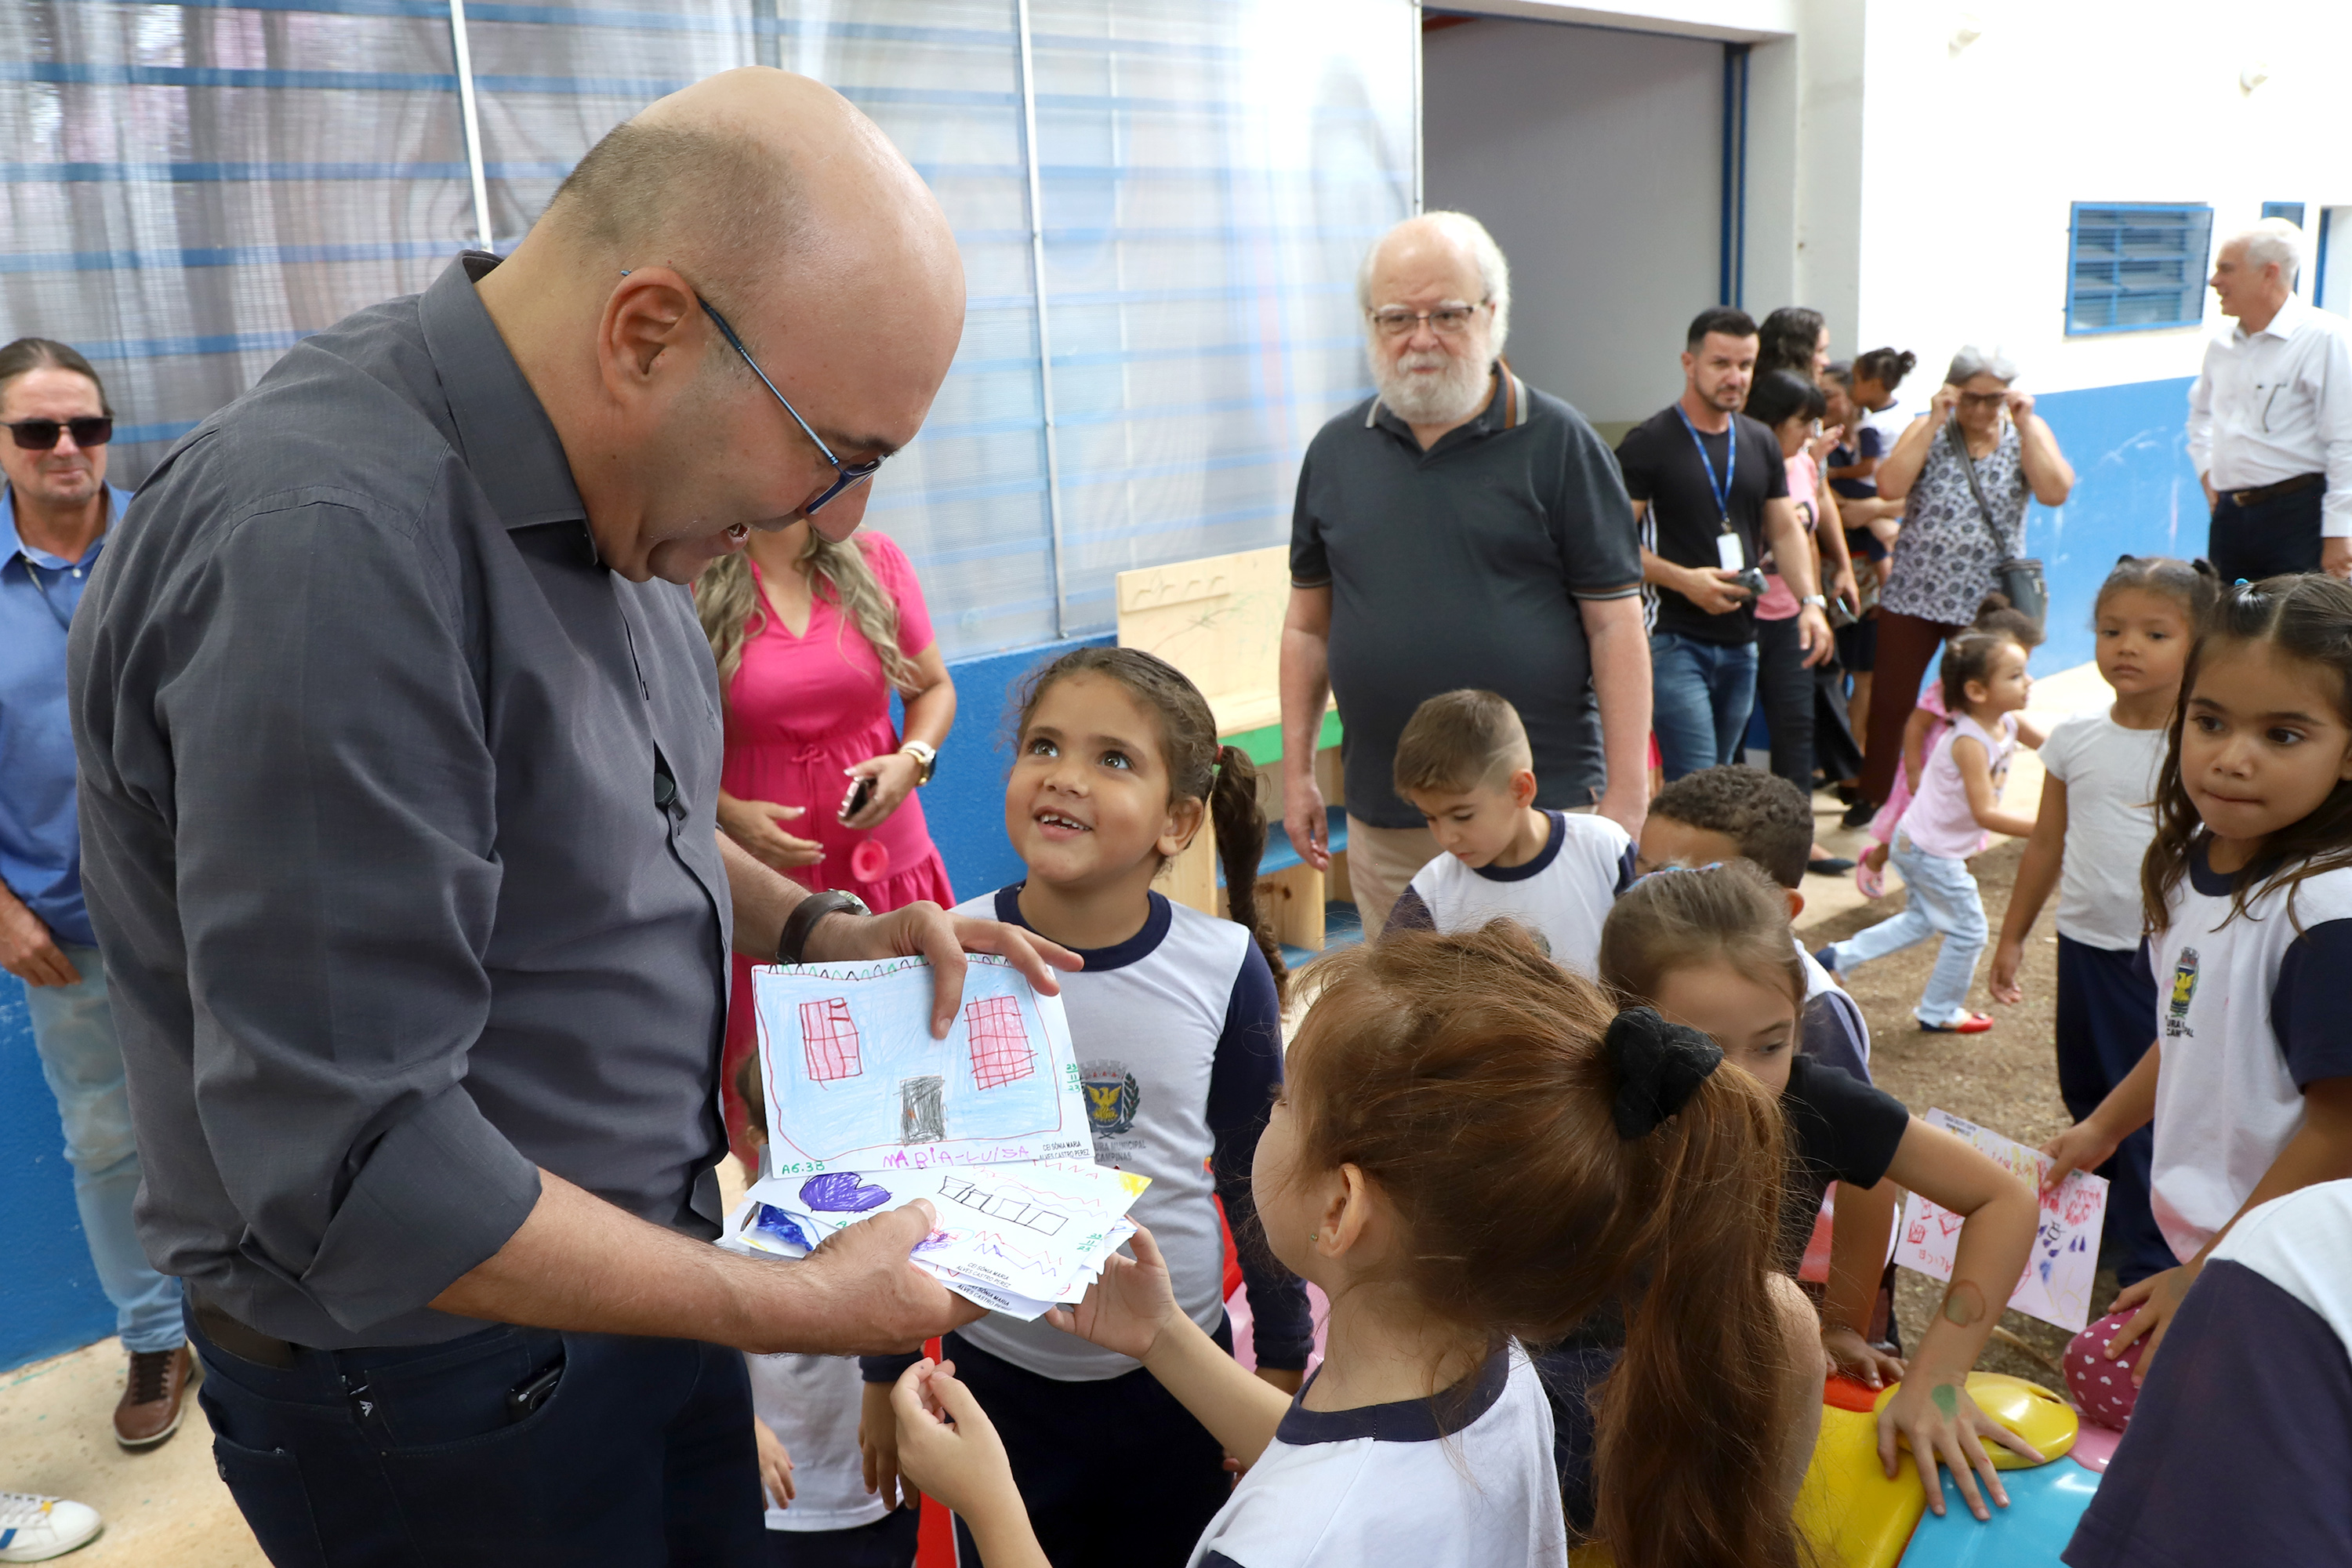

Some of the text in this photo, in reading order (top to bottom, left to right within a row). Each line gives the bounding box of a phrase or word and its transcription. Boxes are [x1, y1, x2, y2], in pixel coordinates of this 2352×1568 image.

[1093, 1139, 1146, 1152] URA MUNICIPAL
[1094, 1152, 1132, 1162] CAMPINAS
[956, 1265, 1011, 1288] ALVES CASTRO PEREZ
[993, 1271, 1009, 1280] MARIA
[957, 1284, 973, 1294] ALVES
[973, 1292, 994, 1305] CASTRO
[993, 1295, 1010, 1306] MARIA
